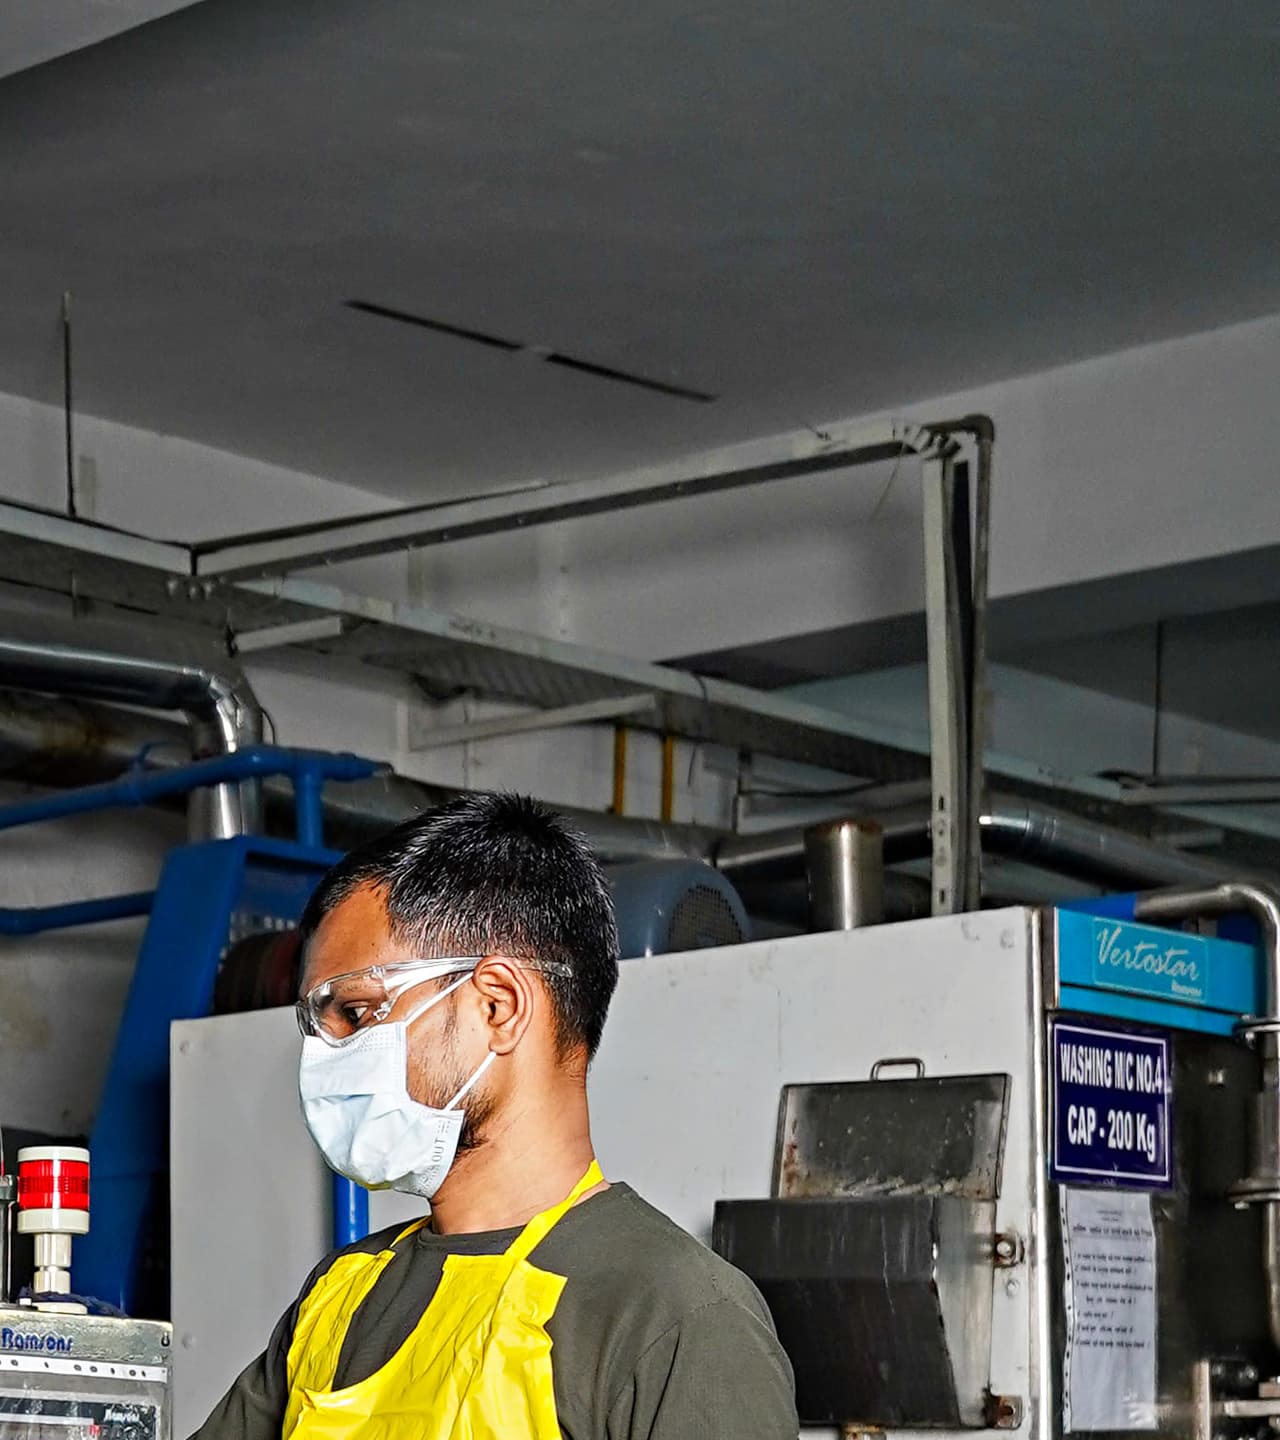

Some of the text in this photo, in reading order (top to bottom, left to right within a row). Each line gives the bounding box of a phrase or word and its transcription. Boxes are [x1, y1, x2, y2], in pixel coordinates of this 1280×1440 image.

[1096, 926, 1200, 981] Vertostar
[1060, 1042, 1112, 1088] WASHING
[1136, 1054, 1163, 1094] NO.4
[432, 1138, 447, 1162] OUT
[1068, 1104, 1097, 1146] CAP
[1108, 1110, 1133, 1151] 200
[1136, 1113, 1156, 1162] Kg
[1, 1328, 74, 1353] Ramsons
